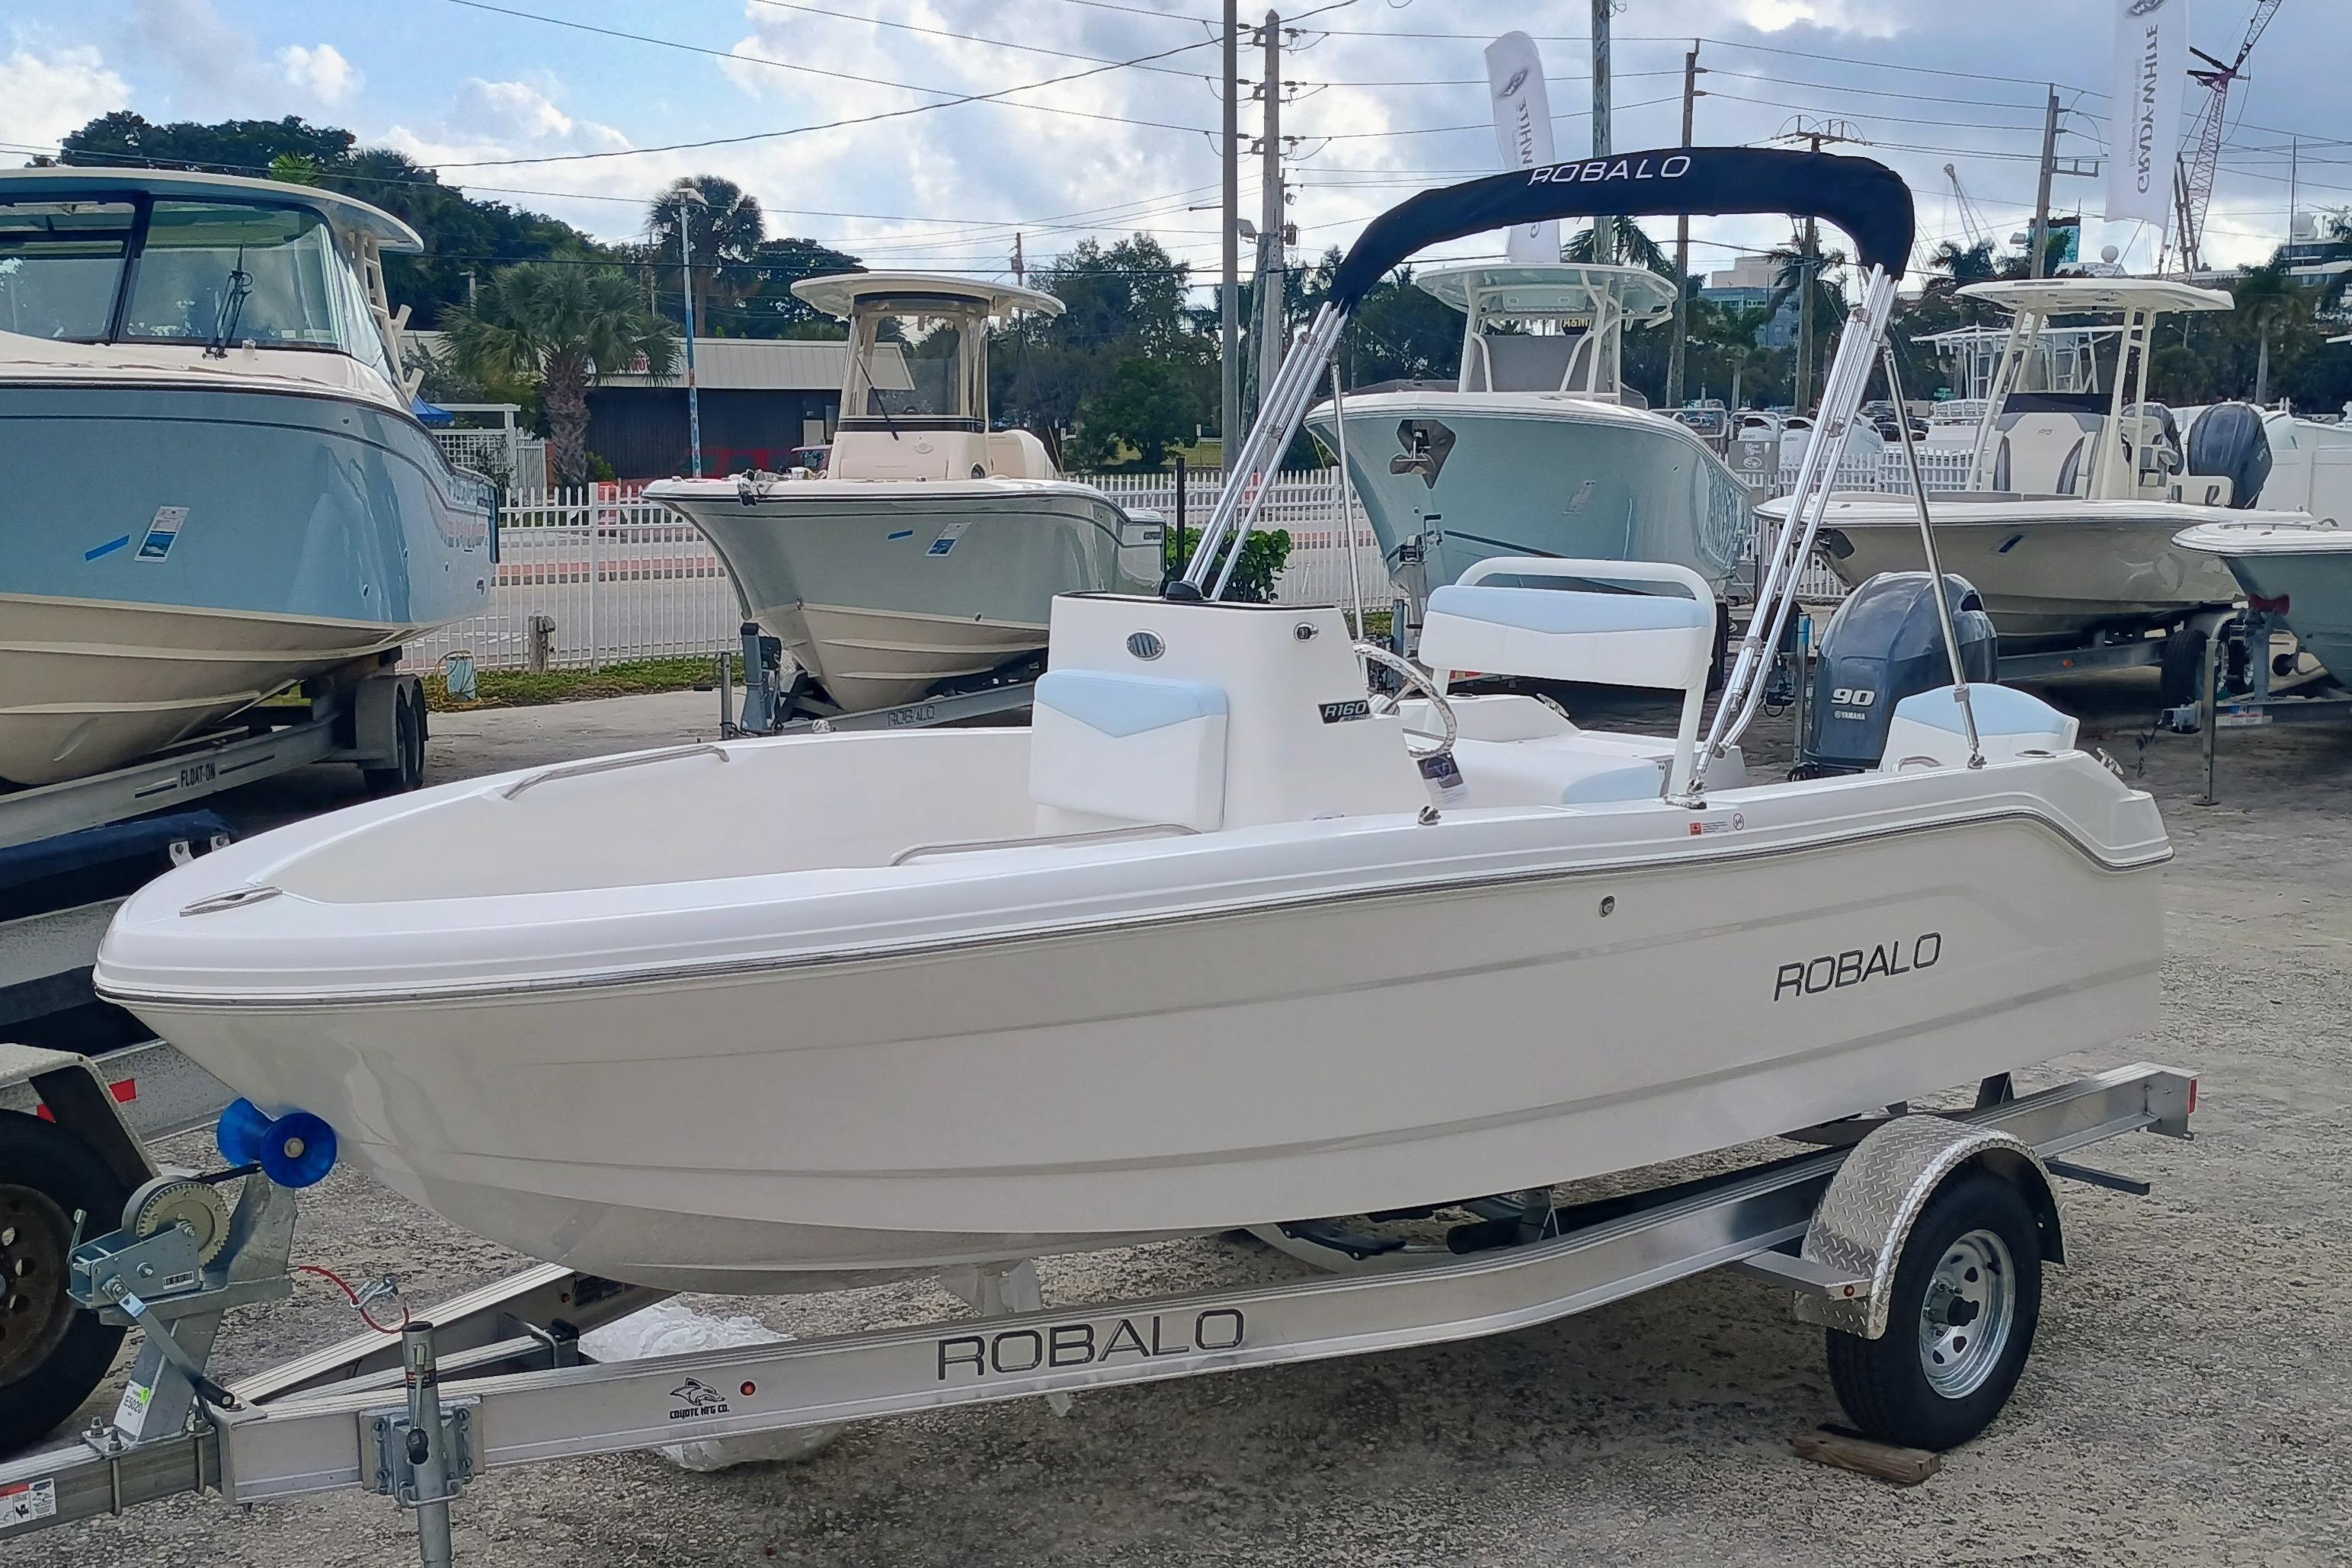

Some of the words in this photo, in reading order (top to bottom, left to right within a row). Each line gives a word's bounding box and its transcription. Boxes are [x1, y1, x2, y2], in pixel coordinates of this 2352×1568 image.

[1527, 155, 1691, 187] ROBALO
[1830, 688, 1875, 706] 90
[888, 705, 936, 726] ROBALO
[1323, 701, 1367, 718] R160
[1841, 711, 1866, 720] YAMAHA
[181, 762, 216, 788] FLOAT-ON
[1773, 932, 1941, 1002] ROBALO
[937, 1308, 1244, 1381] ROBALO
[670, 1407, 699, 1419] COYOTE
[718, 1404, 730, 1413] CO.
